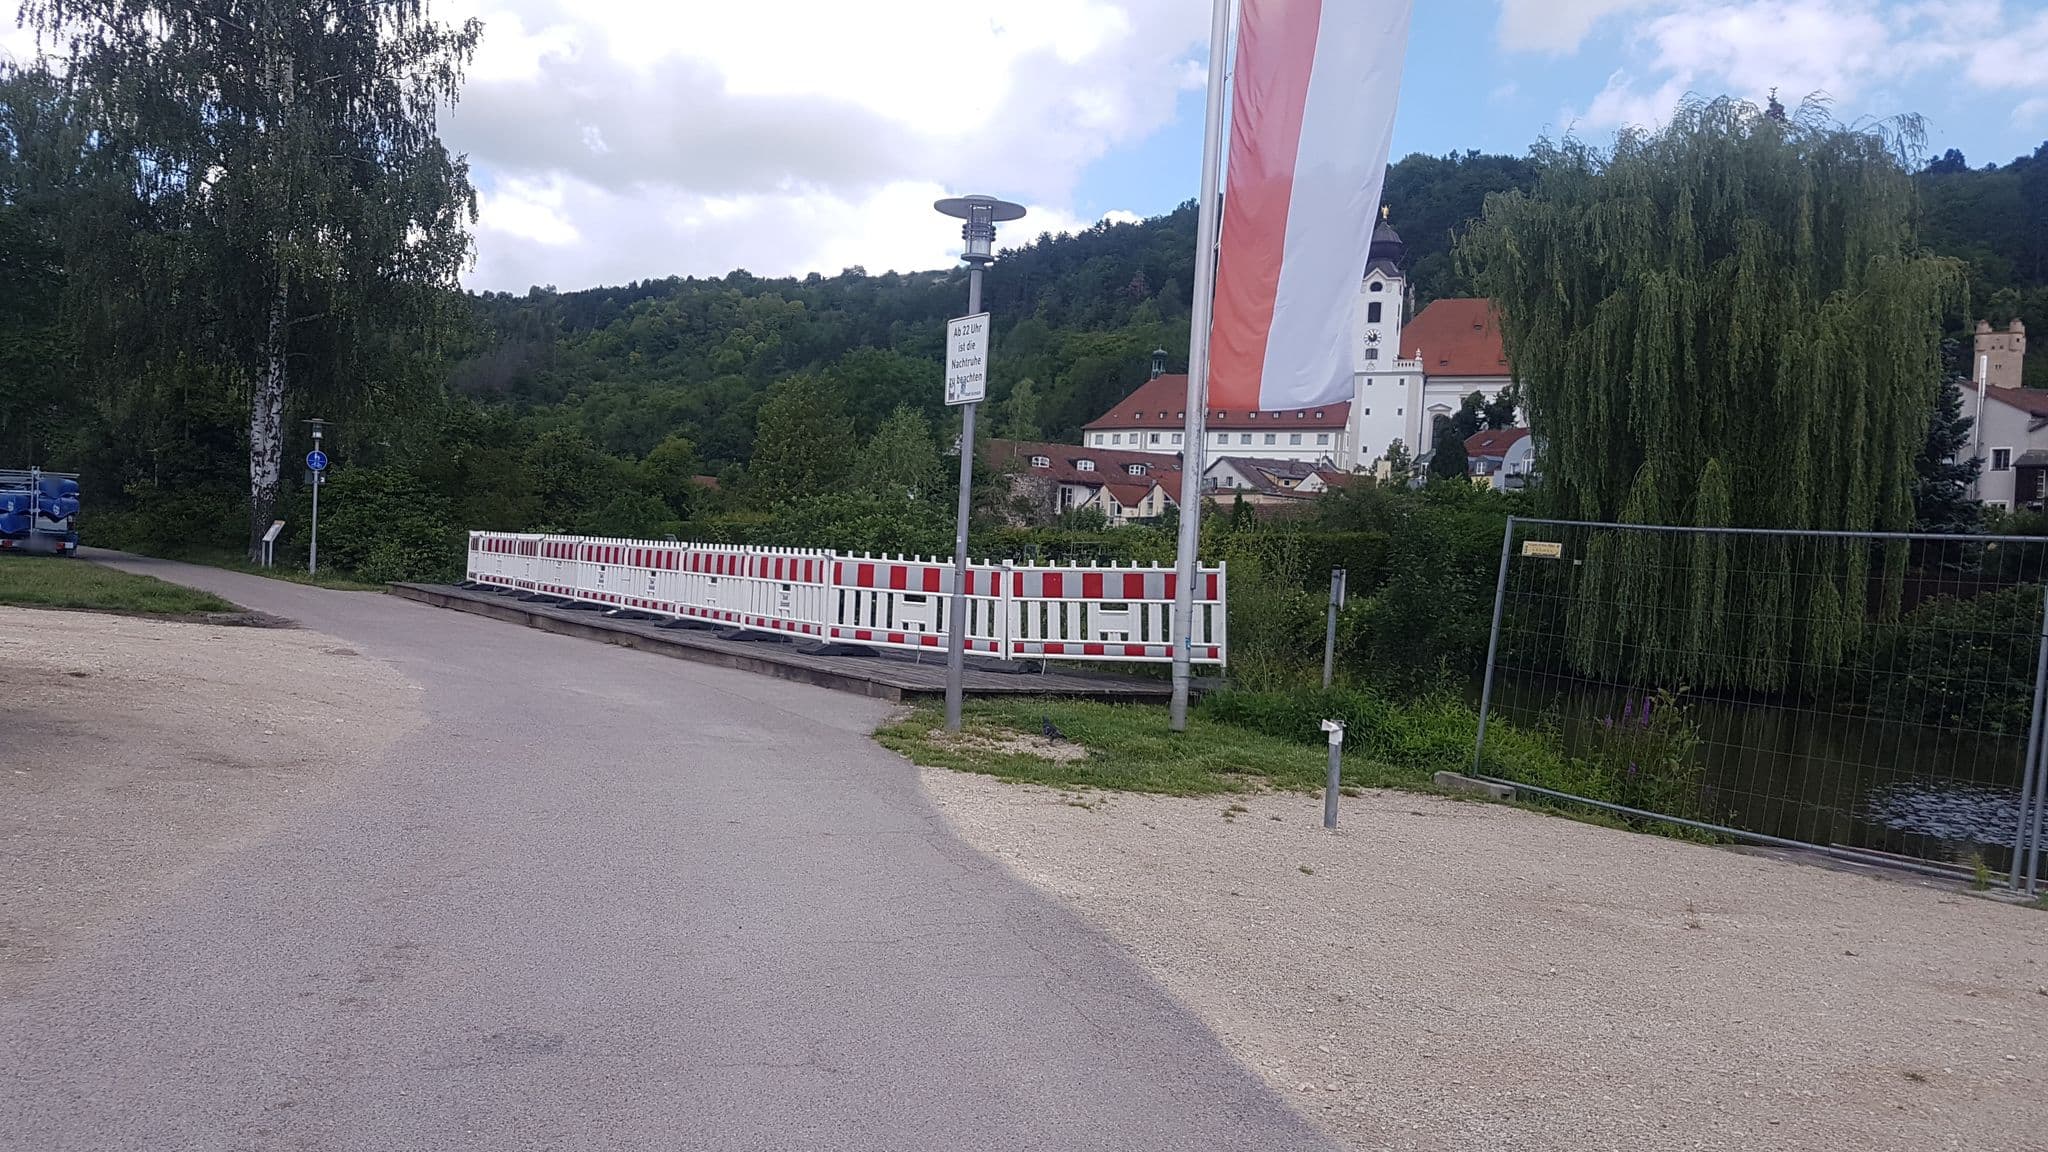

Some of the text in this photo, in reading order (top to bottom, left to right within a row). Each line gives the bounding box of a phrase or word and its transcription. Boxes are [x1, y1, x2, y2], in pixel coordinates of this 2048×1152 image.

[953, 323, 982, 337] Ab 22 Uhr
[966, 340, 975, 350] die
[951, 357, 981, 369] Nachtruhe
[956, 373, 982, 385] beachten
